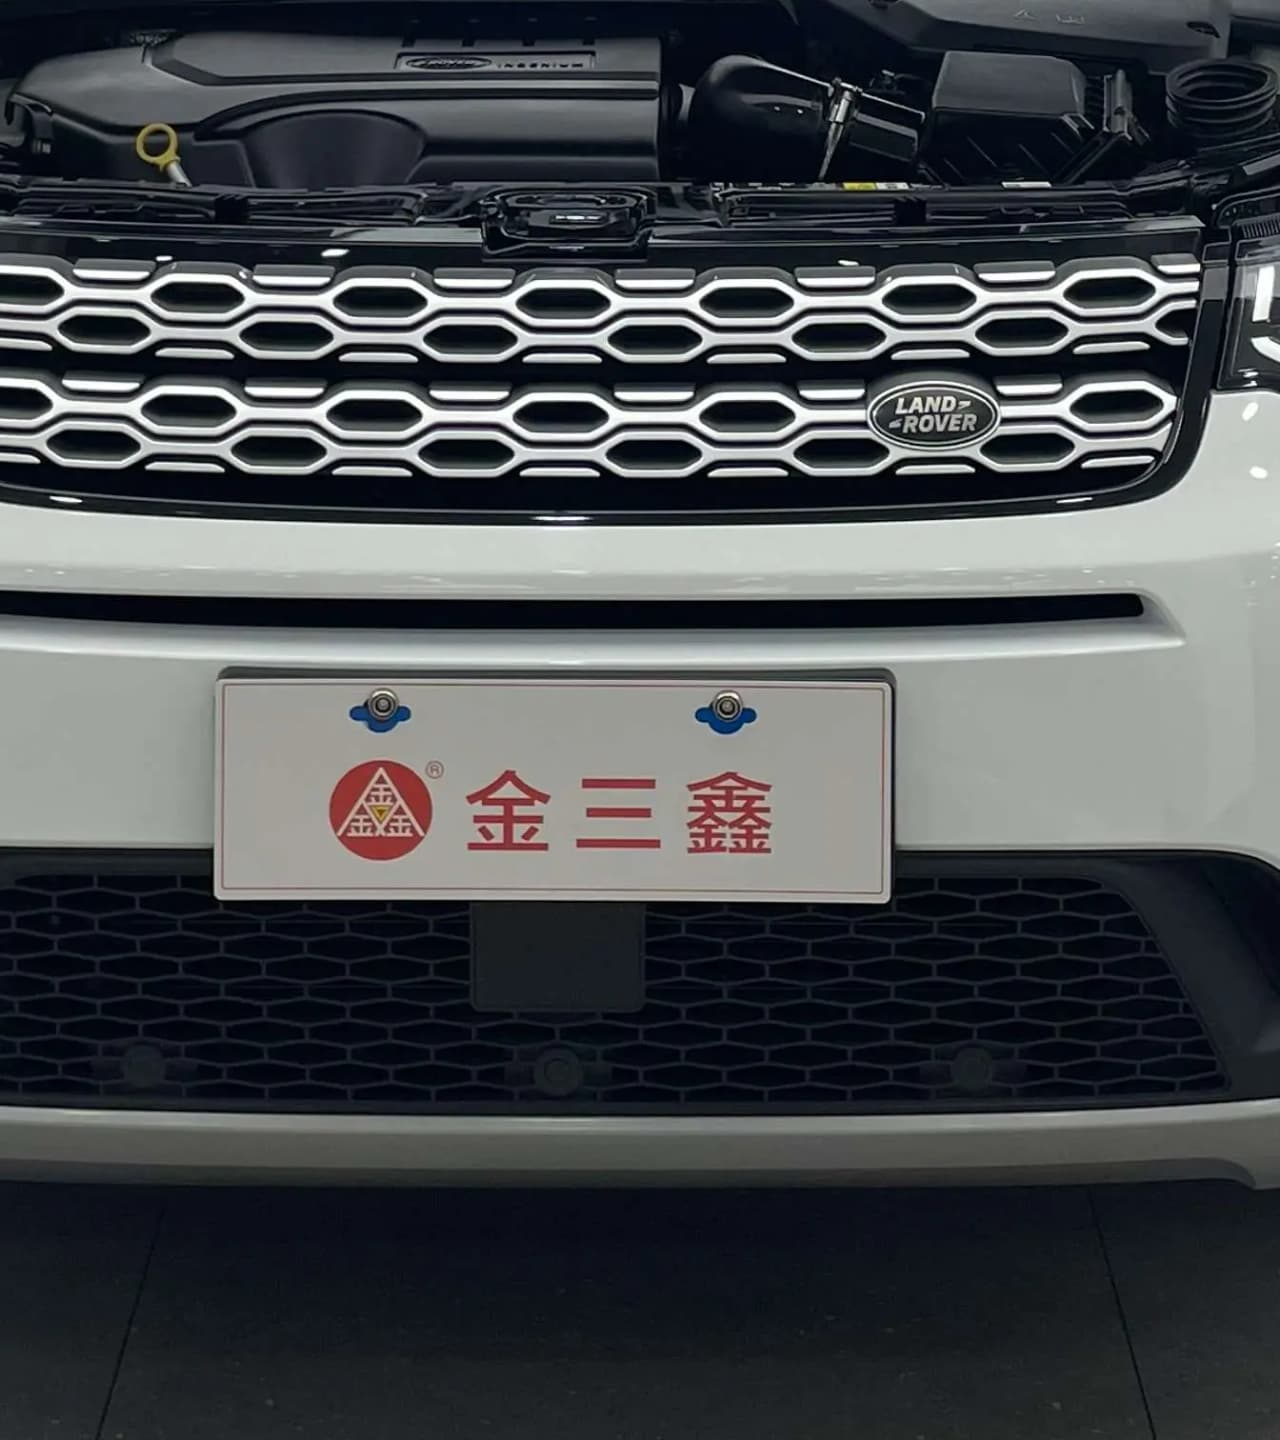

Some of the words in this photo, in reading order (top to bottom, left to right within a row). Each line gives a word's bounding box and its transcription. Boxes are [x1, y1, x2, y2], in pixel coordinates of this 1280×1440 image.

[895, 396, 957, 415] LAND
[902, 413, 978, 434] ROVER
[466, 770, 772, 854] 金三鑫
